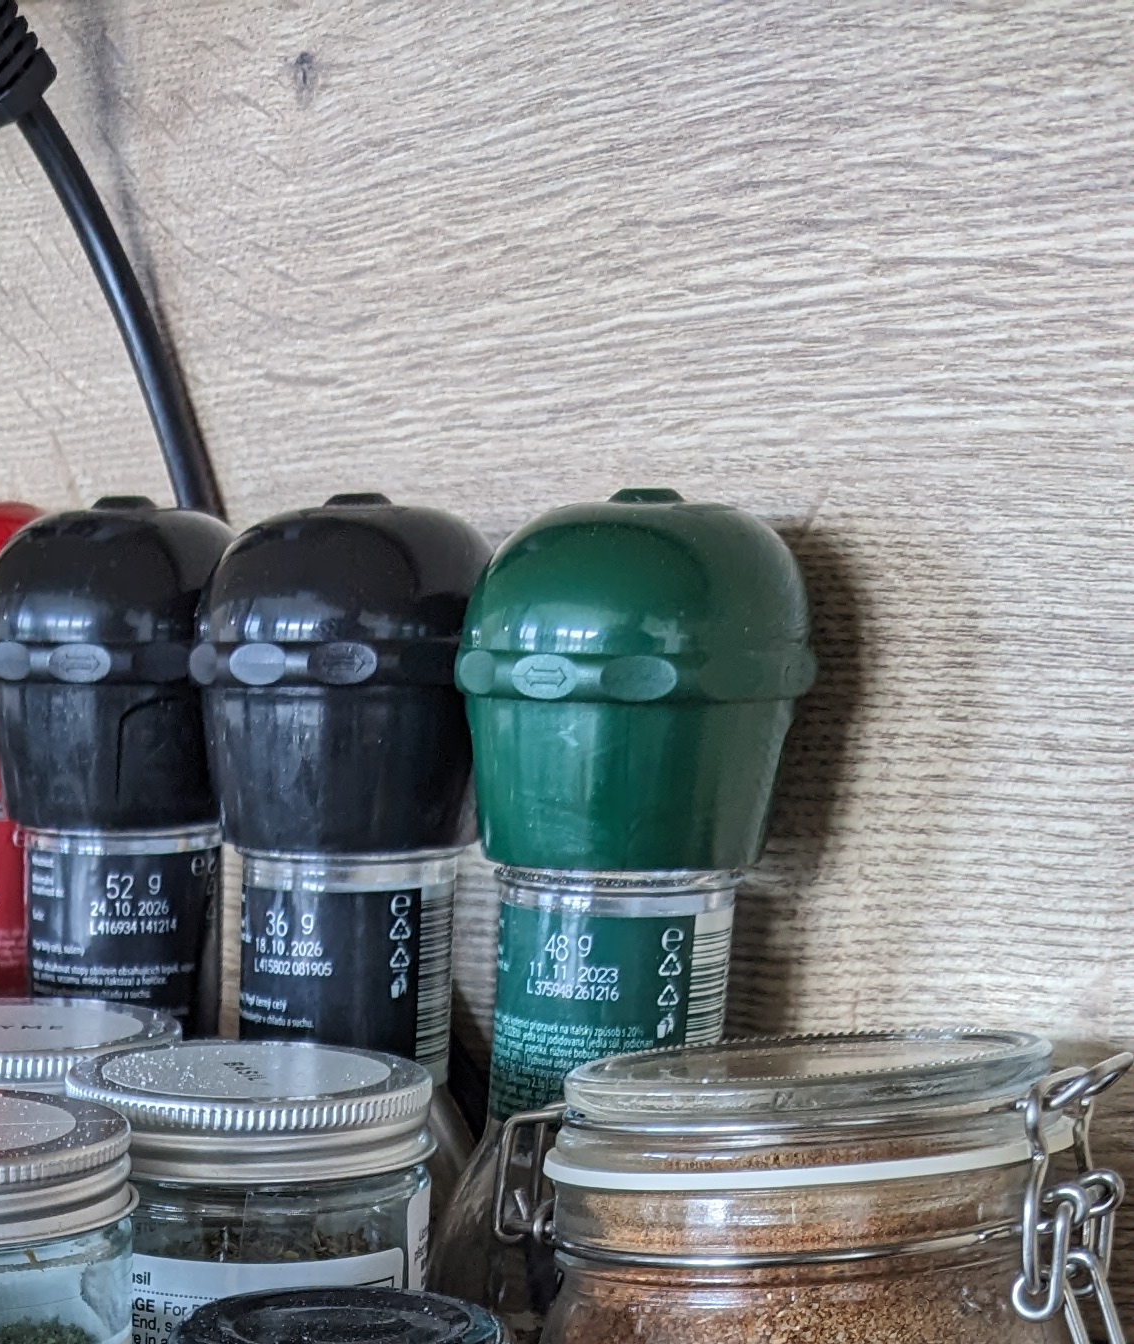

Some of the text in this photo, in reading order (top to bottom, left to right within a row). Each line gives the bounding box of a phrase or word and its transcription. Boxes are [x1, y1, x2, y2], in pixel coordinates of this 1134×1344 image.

[106, 873, 162, 899] 52 g
[90, 900, 169, 918] 24.10.2026
[265, 910, 288, 937] 36
[301, 913, 314, 934] g
[255, 937, 323, 957] 18.10.2026
[545, 933, 593, 962] 48 g
[529, 961, 619, 983] 11.11.2023
[574, 985, 620, 1001] 261216
[163, 1301, 186, 1316] For
